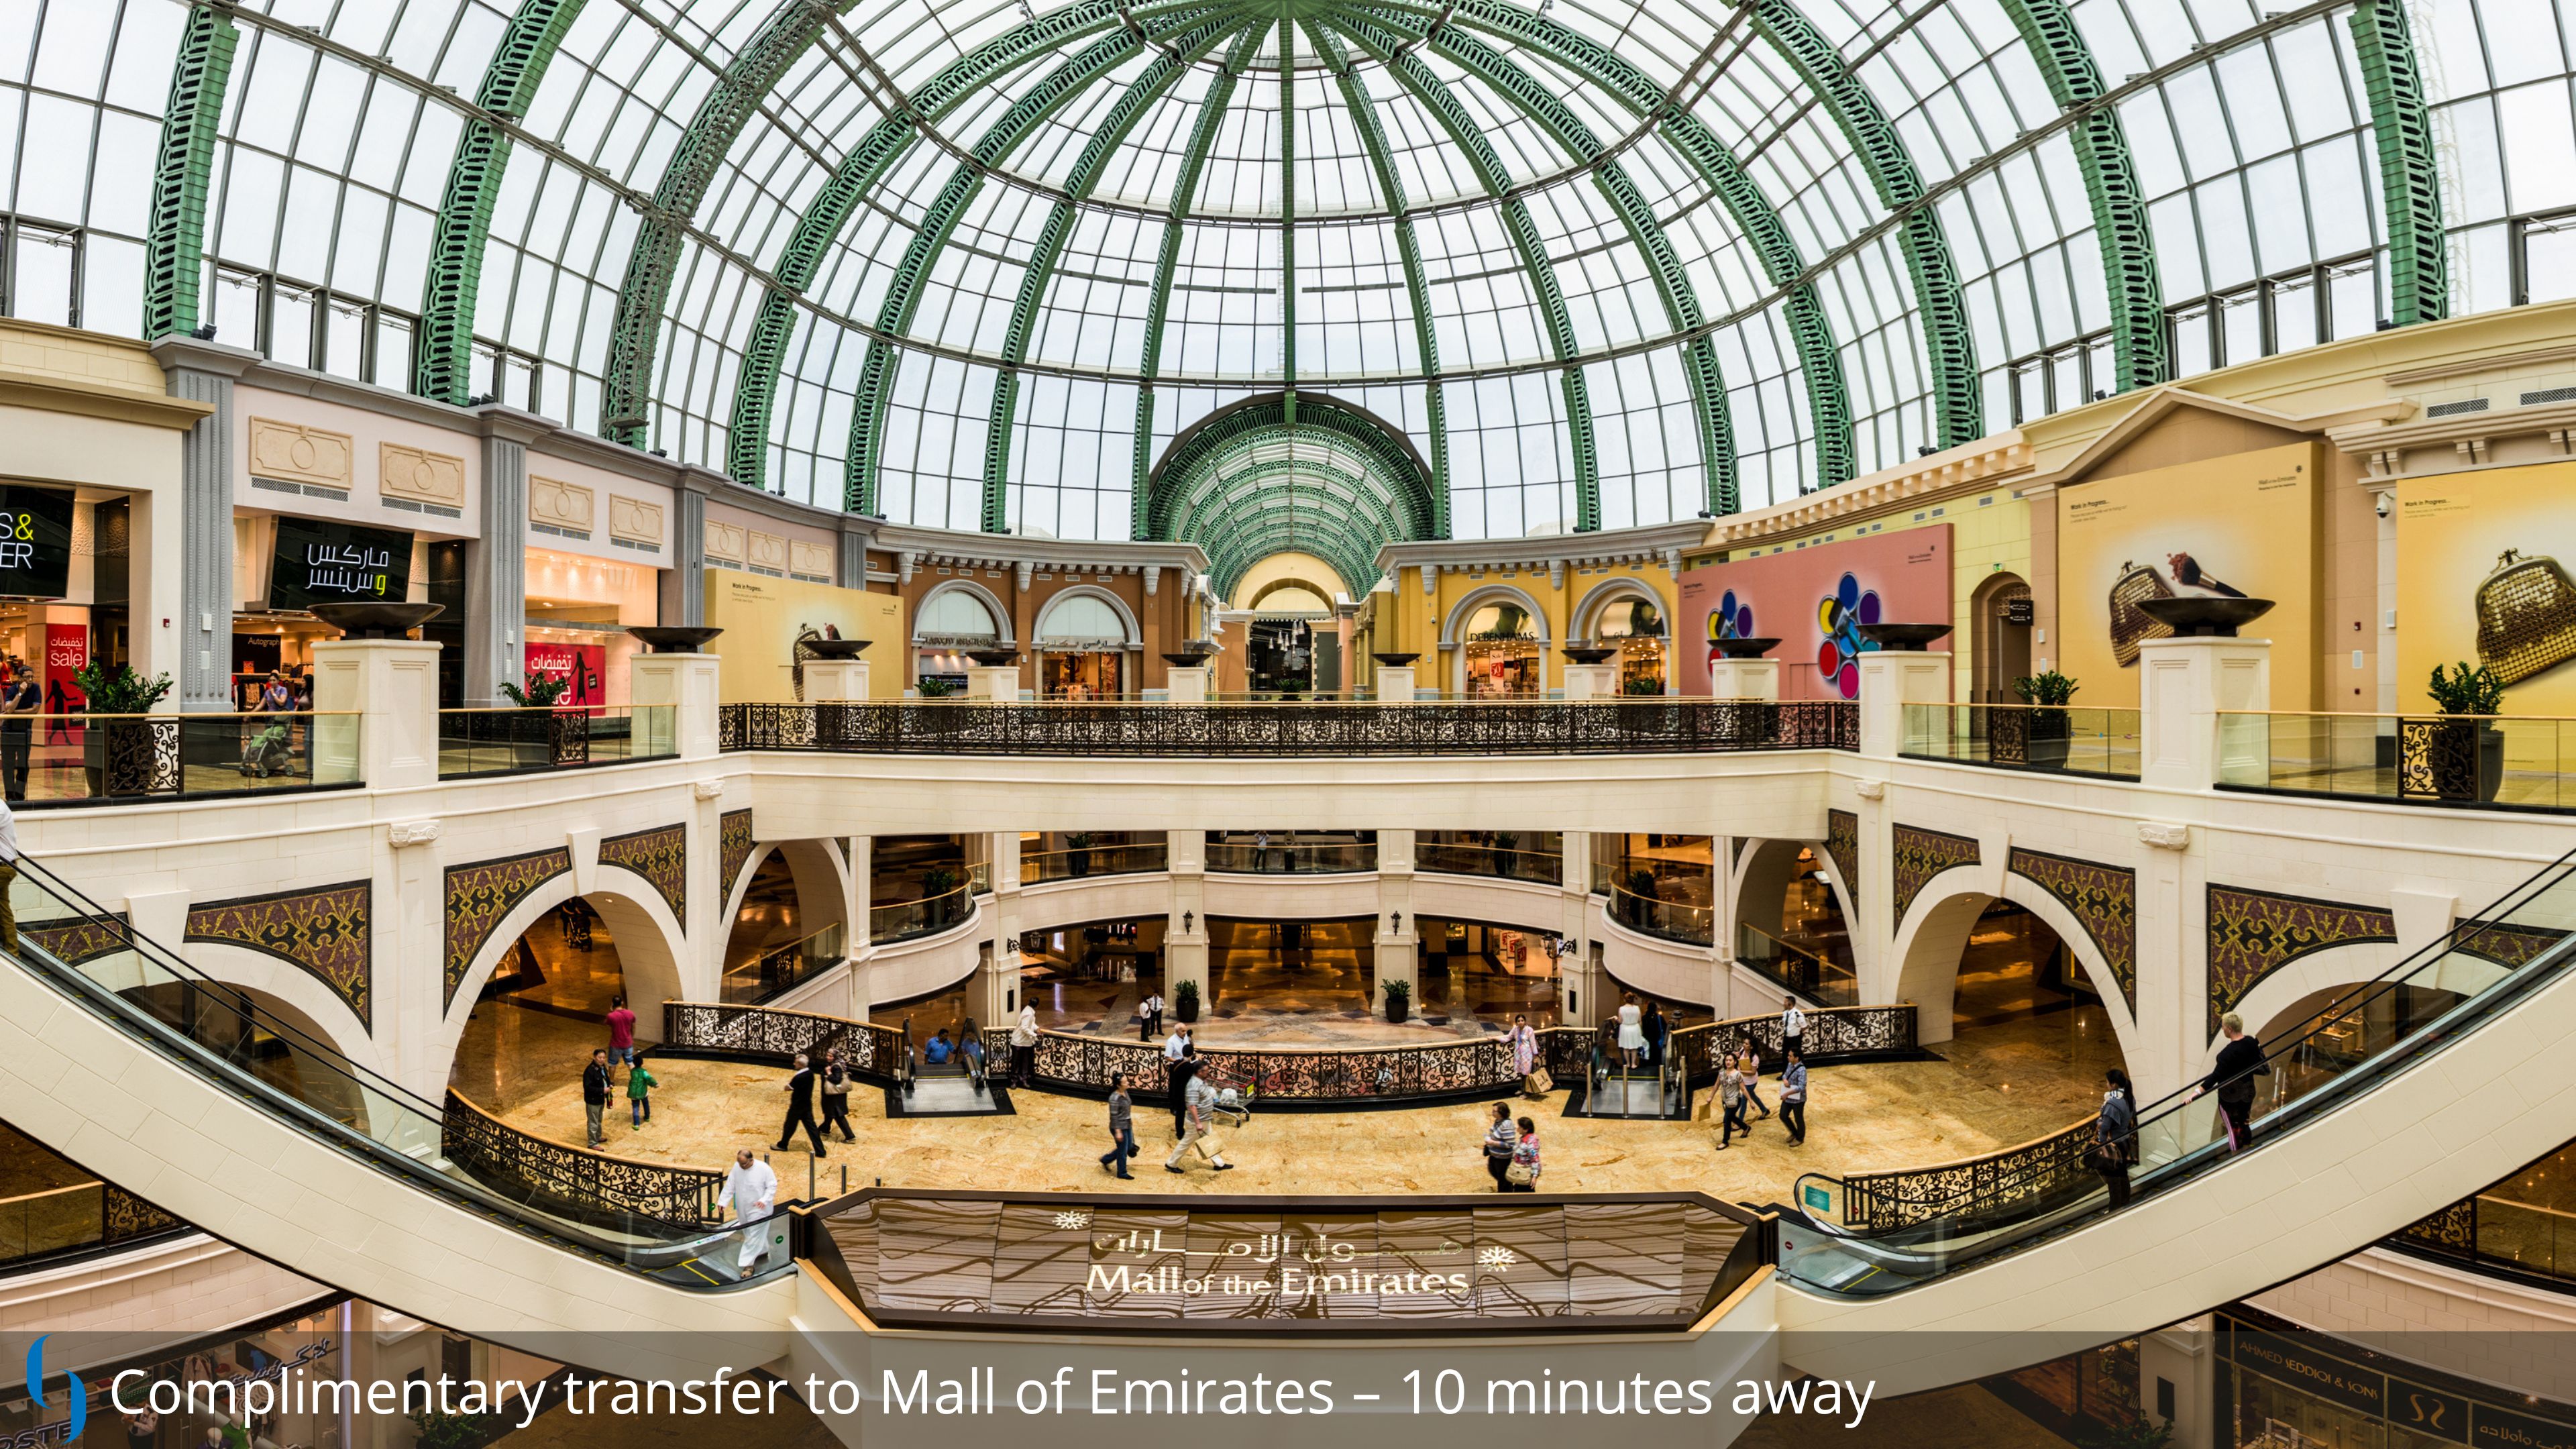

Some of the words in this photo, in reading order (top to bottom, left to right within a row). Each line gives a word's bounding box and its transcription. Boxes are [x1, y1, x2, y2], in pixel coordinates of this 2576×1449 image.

[0, 542, 33, 569] ER
[308, 543, 388, 570] ماركس
[50, 637, 83, 649] تخفيضات
[248, 637, 280, 647] Autograph
[1470, 632, 1534, 641] DEBENHAMS
[50, 649, 83, 667] sale
[531, 653, 572, 675] تخفيضات
[1303, 1234, 1463, 1263] مول
[1086, 1264, 1183, 1293] Mall
[1183, 1274, 1216, 1294] of
[1222, 1275, 1272, 1295] the
[1281, 1267, 1469, 1295] Emirates
[2239, 1340, 2283, 1364] AHMED
[2334, 1377, 2344, 1389] &
[2347, 1380, 2378, 1400] SONS
